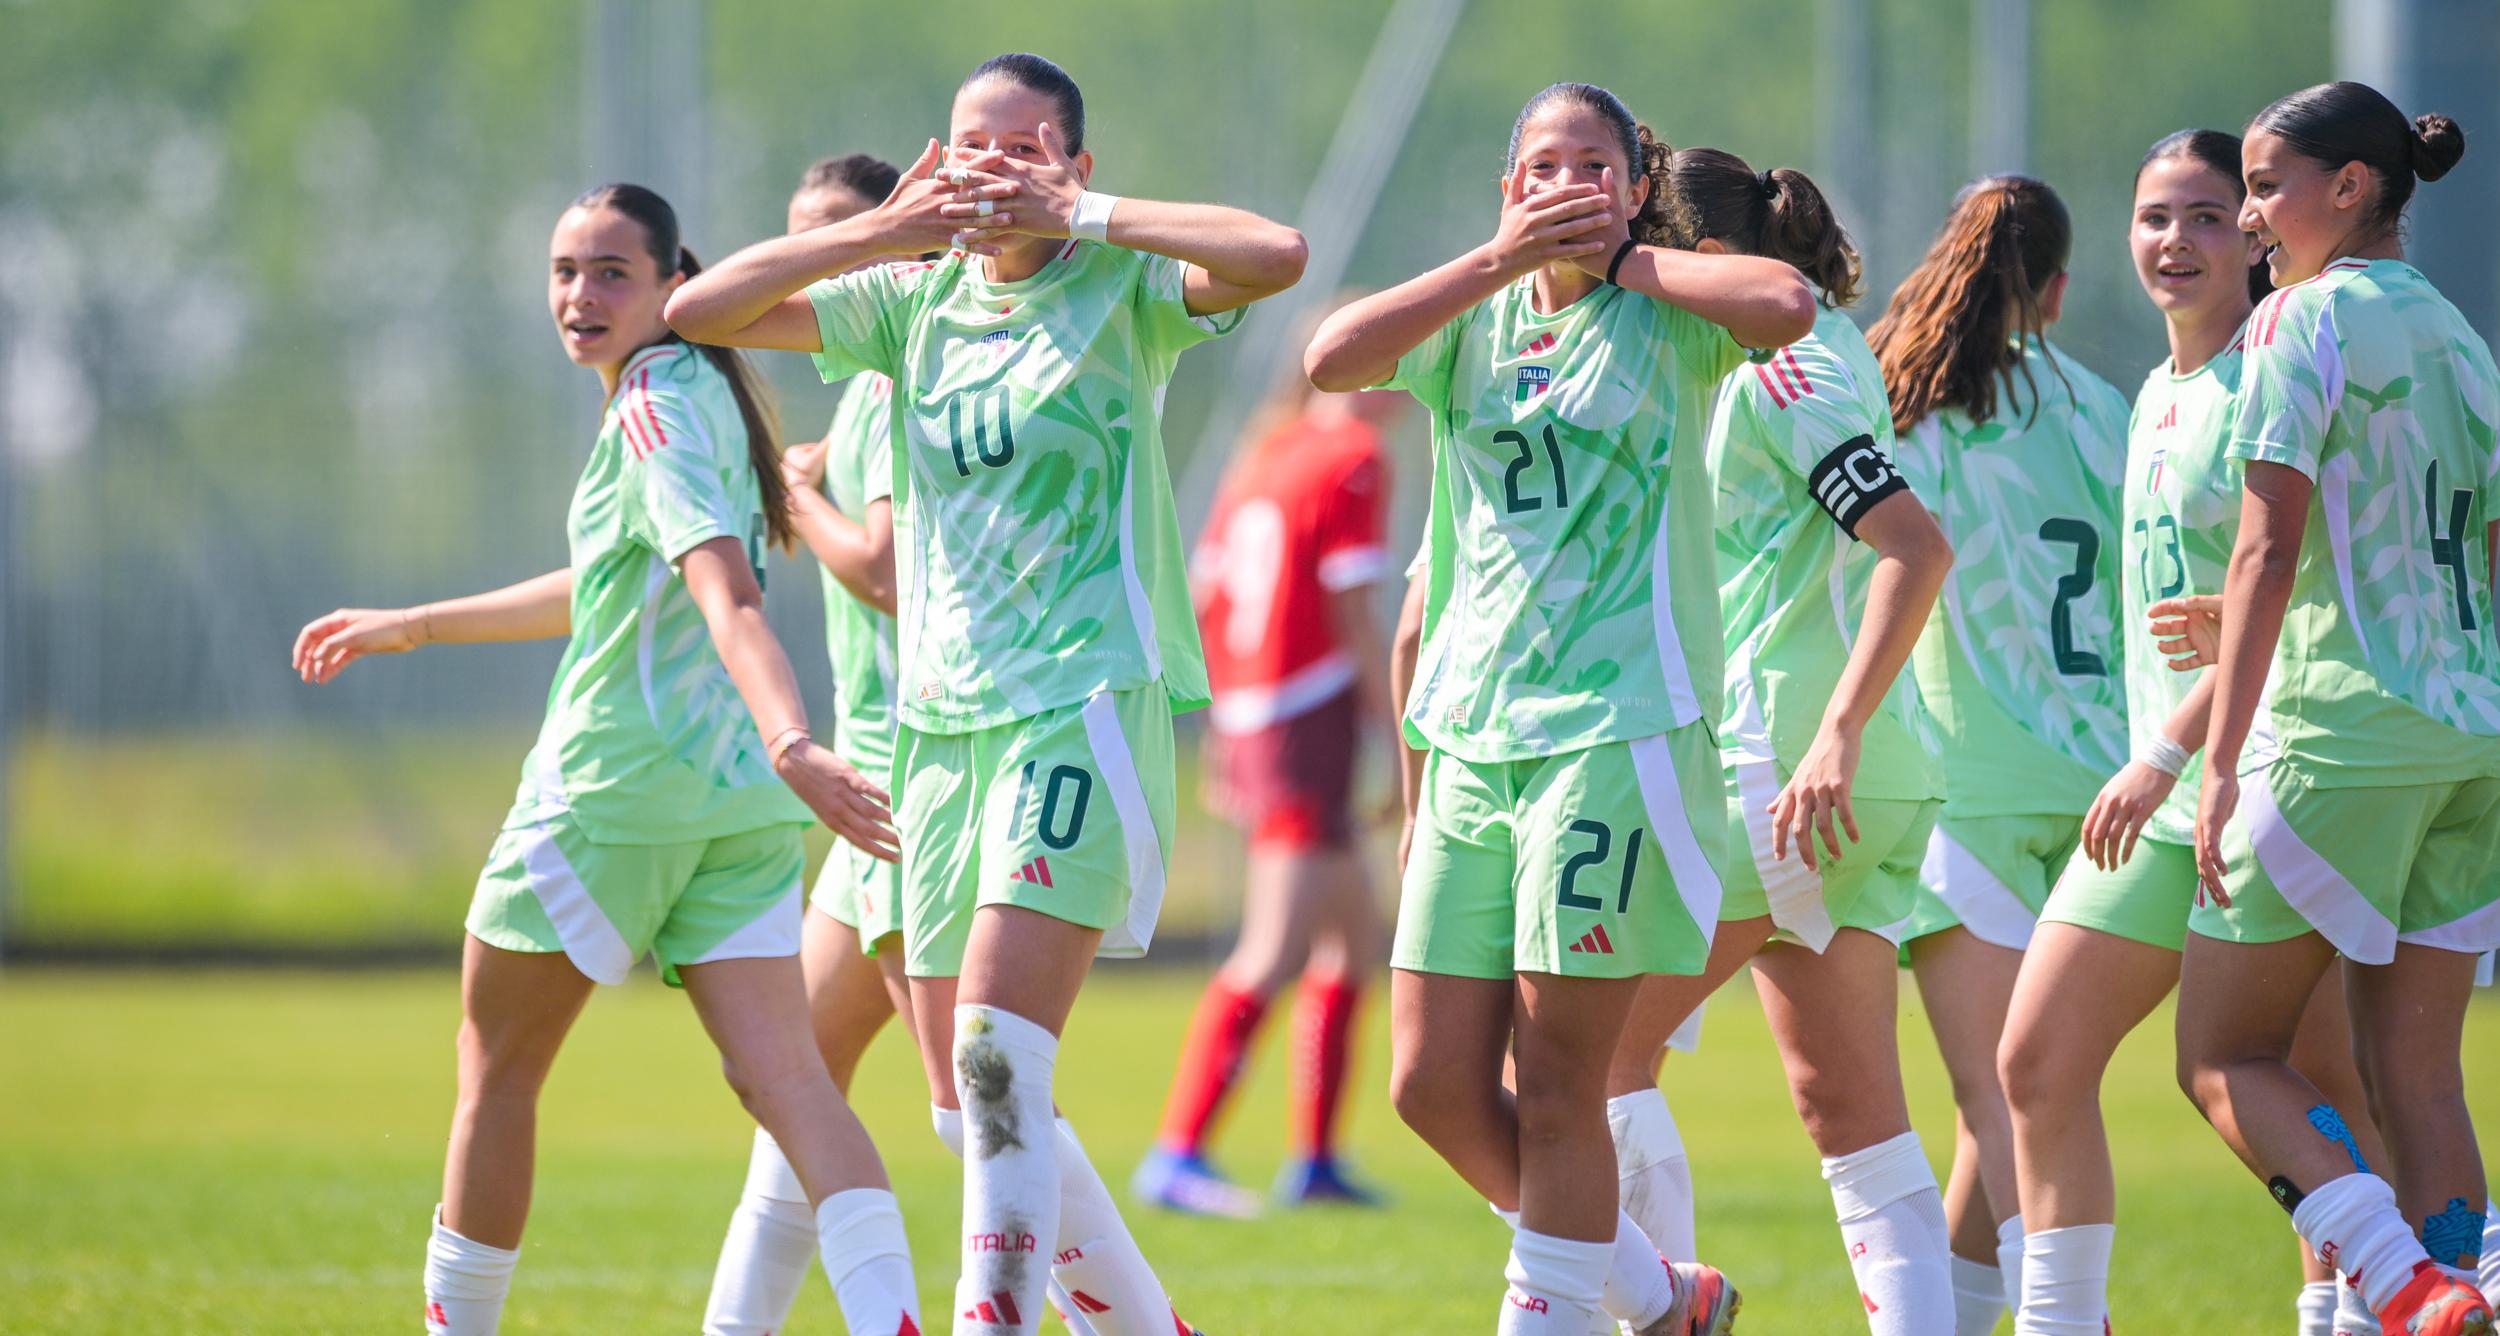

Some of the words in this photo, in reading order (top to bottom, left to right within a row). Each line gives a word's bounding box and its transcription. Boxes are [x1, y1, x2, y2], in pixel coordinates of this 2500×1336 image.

[1519, 369, 1549, 380] ITALIA
[949, 384, 1015, 477] 10
[1492, 423, 1569, 514] 21
[1844, 448, 1889, 493] C
[2425, 458, 2477, 630] 4
[2039, 517, 2108, 677] 2
[1007, 760, 1092, 850] 10
[1557, 819, 1643, 914] 21
